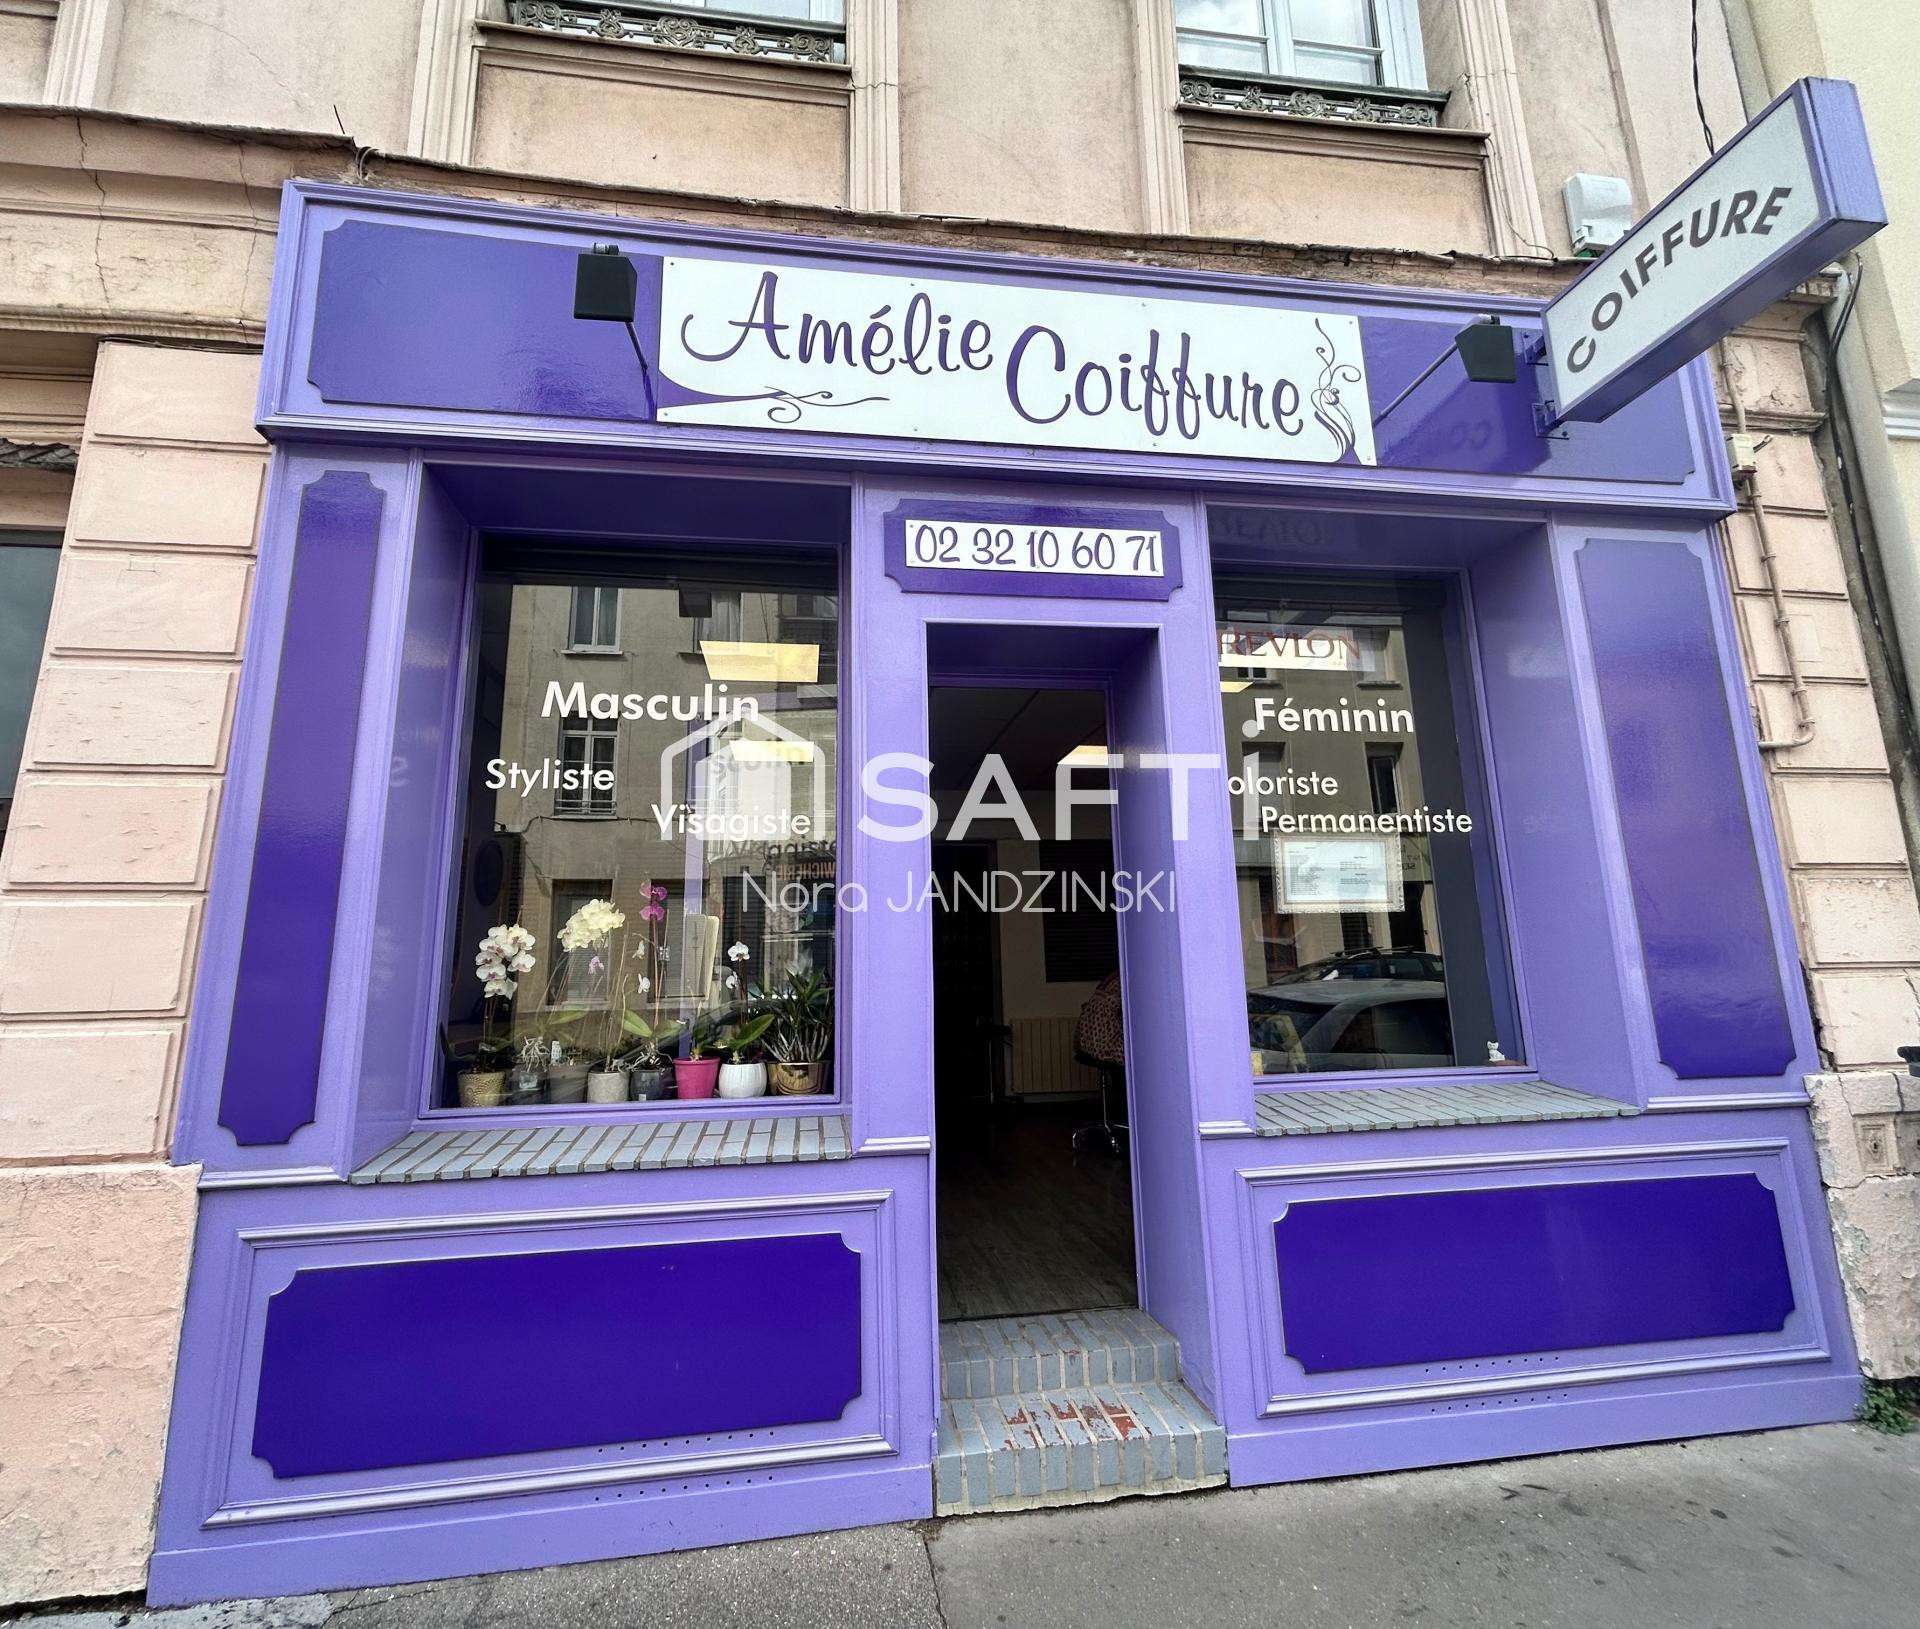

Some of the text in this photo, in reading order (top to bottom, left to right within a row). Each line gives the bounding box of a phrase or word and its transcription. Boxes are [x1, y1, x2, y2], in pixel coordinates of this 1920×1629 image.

[1567, 187, 1792, 373] COIFFURE
[681, 271, 1303, 440] Amélie Coiffure
[915, 524, 1157, 572] 02 32 10 60 71
[1217, 627, 1361, 660] REVLON
[540, 680, 759, 722] Masculin
[1254, 697, 1415, 733] Féminin
[485, 758, 615, 797] Styliste
[1227, 766, 1339, 796] oloriste
[650, 803, 811, 842] Visagiste
[1261, 805, 1473, 834] Permanentiste
